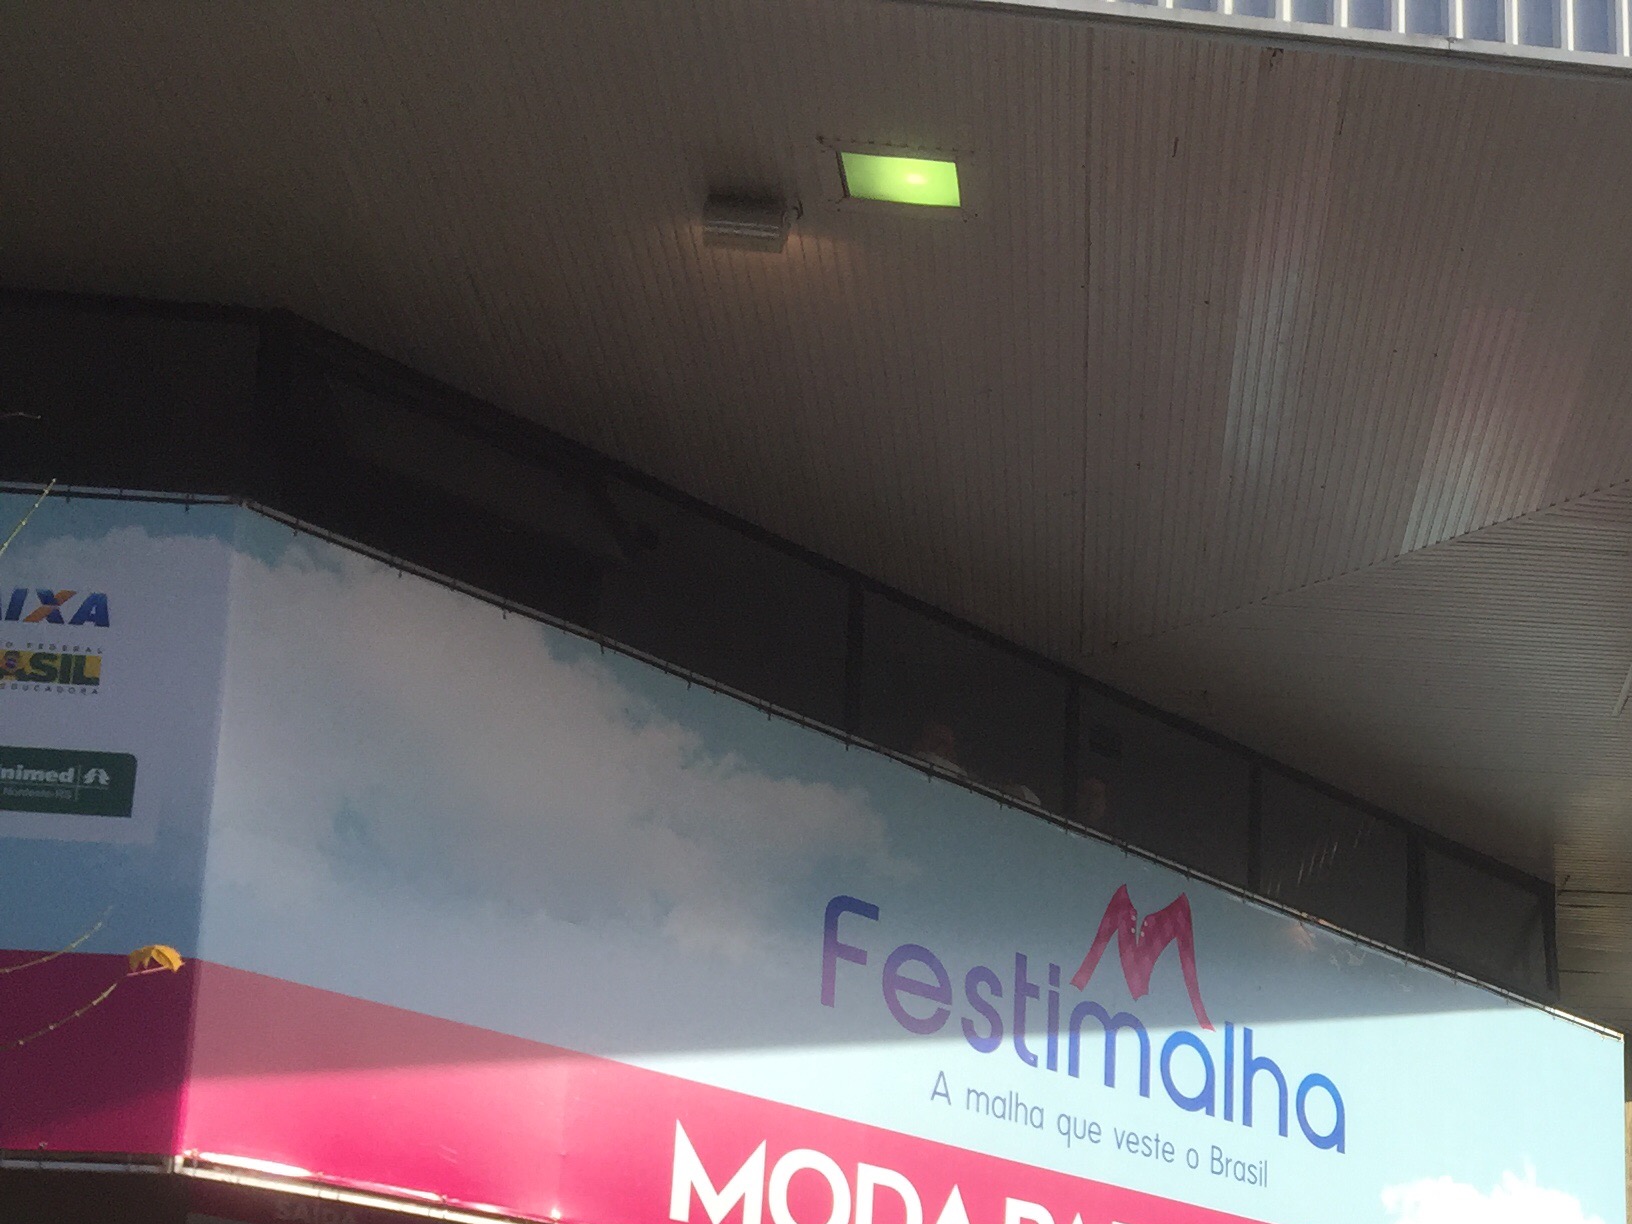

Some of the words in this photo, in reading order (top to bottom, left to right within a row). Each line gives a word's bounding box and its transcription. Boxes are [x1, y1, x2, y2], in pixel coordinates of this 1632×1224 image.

[0, 588, 109, 627] IXA
[0, 764, 75, 783] nimed
[819, 894, 1346, 1154] Festimalha
[930, 1070, 952, 1107] A
[966, 1081, 1045, 1131] malha
[1057, 1109, 1102, 1149] que
[1113, 1125, 1176, 1165] veste
[1186, 1144, 1200, 1171] o
[1210, 1145, 1269, 1189] Brasil
